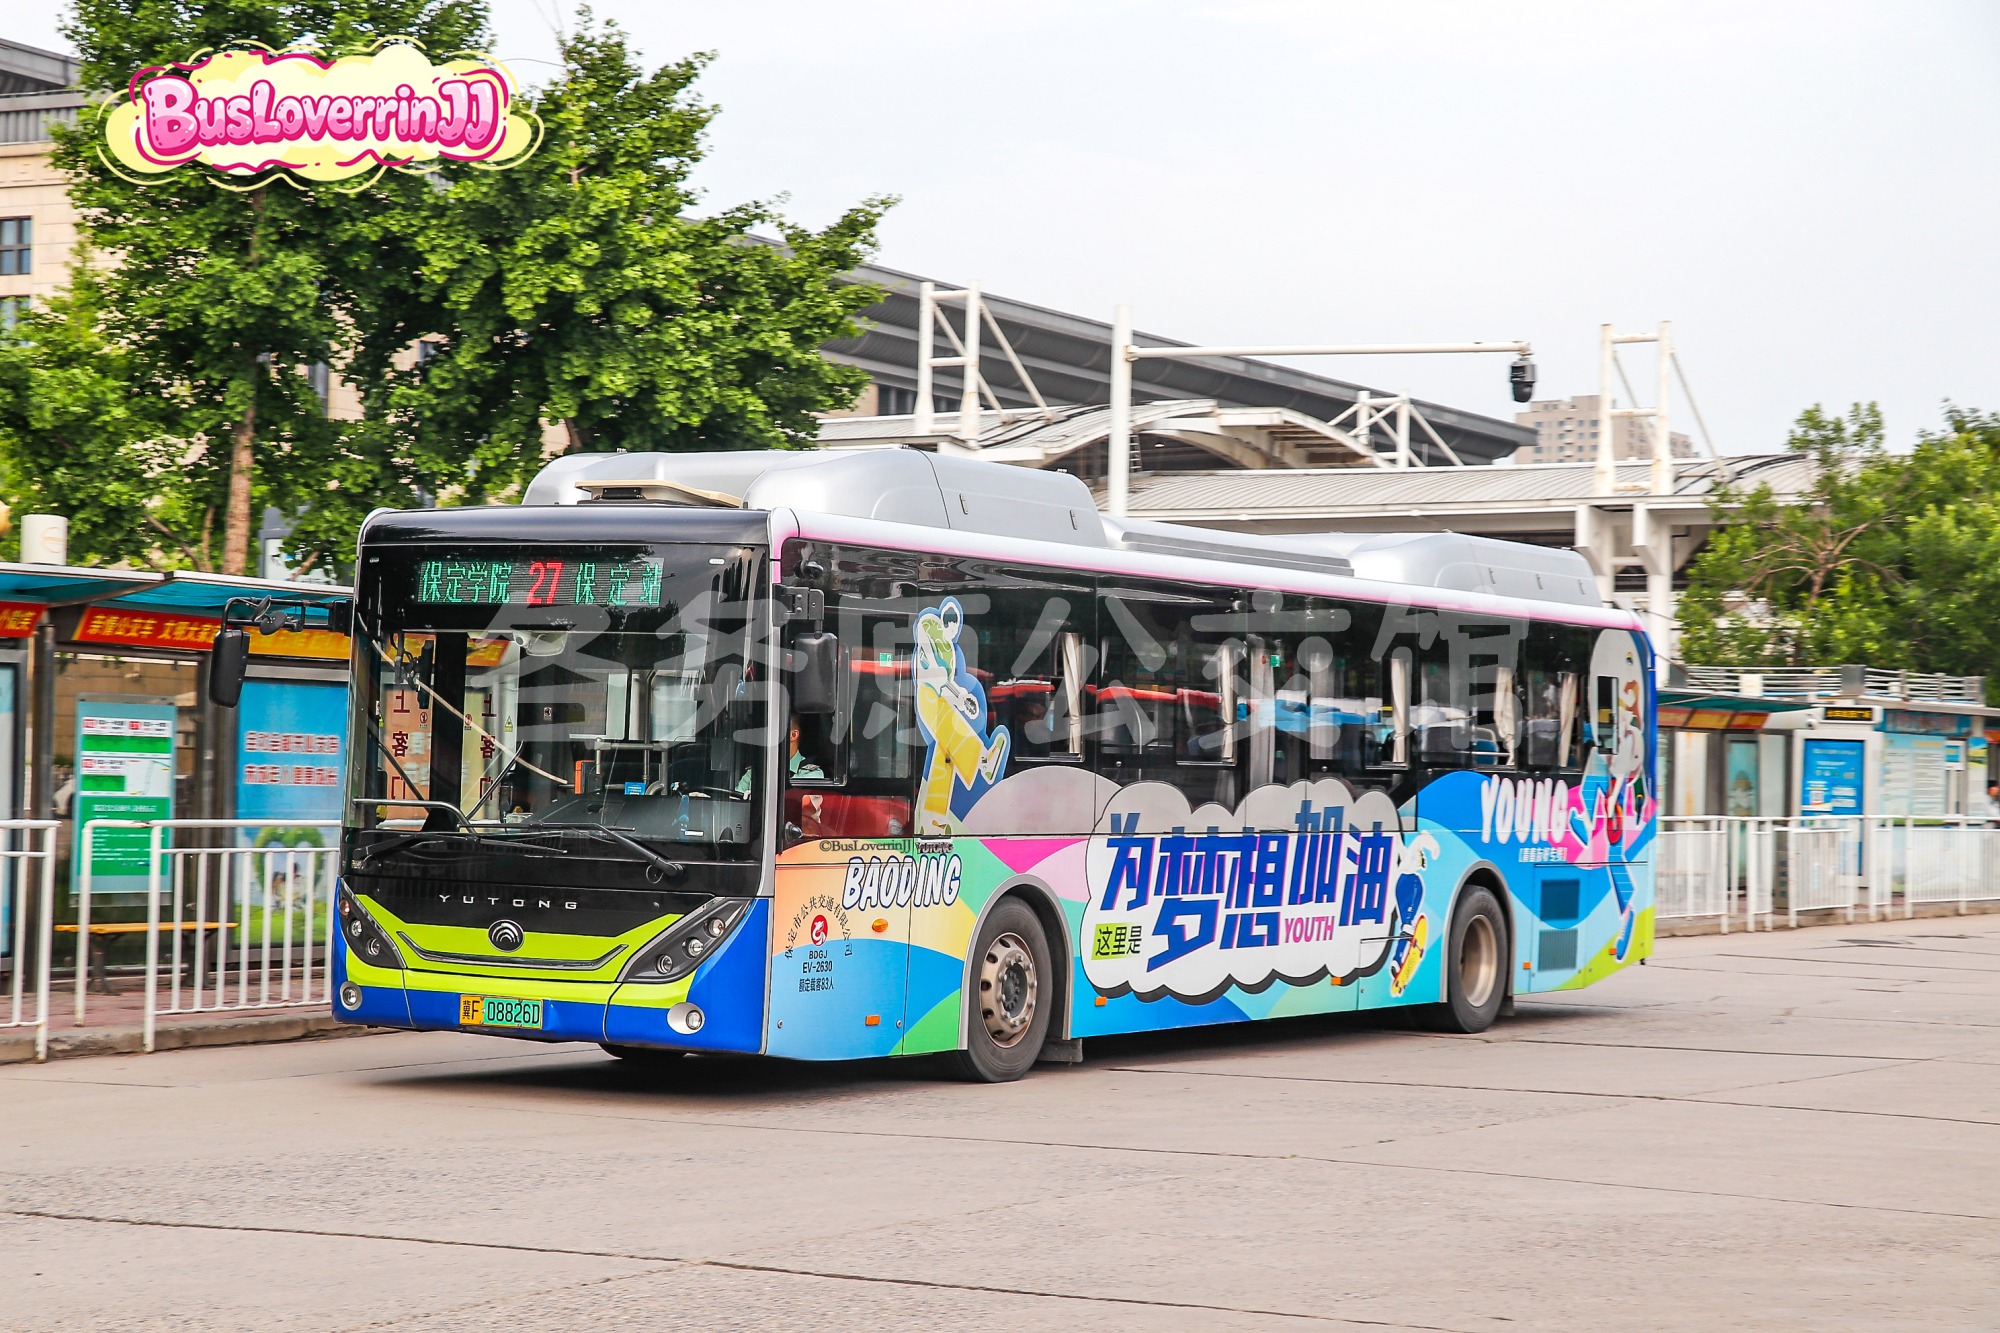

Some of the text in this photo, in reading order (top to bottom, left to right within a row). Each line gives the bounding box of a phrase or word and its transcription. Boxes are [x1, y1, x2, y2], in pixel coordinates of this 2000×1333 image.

[421, 561, 512, 603] 保定学院
[527, 562, 563, 604] 27
[1481, 774, 1569, 845] YOUNG
[842, 853, 962, 912] BAODING
[1100, 800, 1394, 974] 为梦想加油
[438, 894, 578, 911] YUTONG
[785, 893, 853, 960] 保定市公共交通有限公司
[1095, 925, 1143, 957] 这里是
[1284, 916, 1335, 944] YOUTH
[802, 960, 833, 974] EV-2630
[808, 949, 828, 960] BDGJ
[798, 976, 834, 993] 额定载客83人
